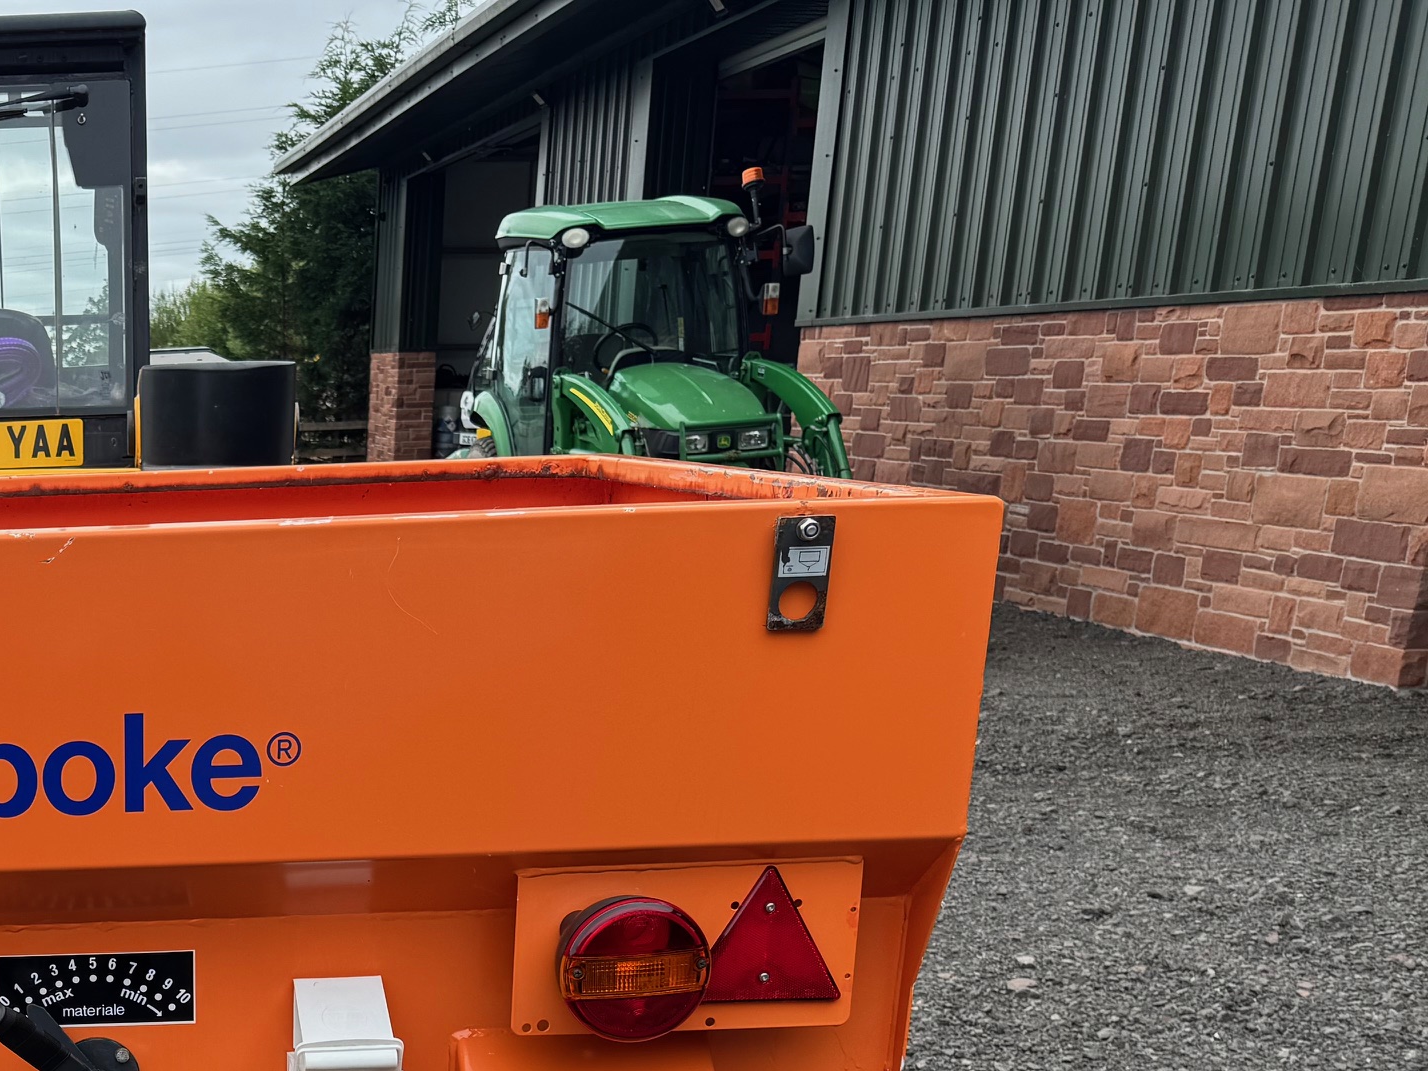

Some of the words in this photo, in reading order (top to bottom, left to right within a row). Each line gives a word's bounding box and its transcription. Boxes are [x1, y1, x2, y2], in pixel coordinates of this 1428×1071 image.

[6, 423, 76, 459] YAA
[0, 995, 10, 1007] 0
[13, 983, 24, 994] 1
[30, 972, 42, 985] 2
[49, 964, 59, 976] 3
[68, 958, 77, 971] 4
[88, 957, 97, 969] 5
[108, 957, 117, 970] 6
[129, 961, 138, 974] 7
[145, 968, 156, 981] 8
[162, 978, 173, 990] 9
[175, 988, 191, 1004] 10
[41, 988, 74, 1007] max
[120, 988, 147, 1006] min
[62, 1003, 125, 1017] materiale
